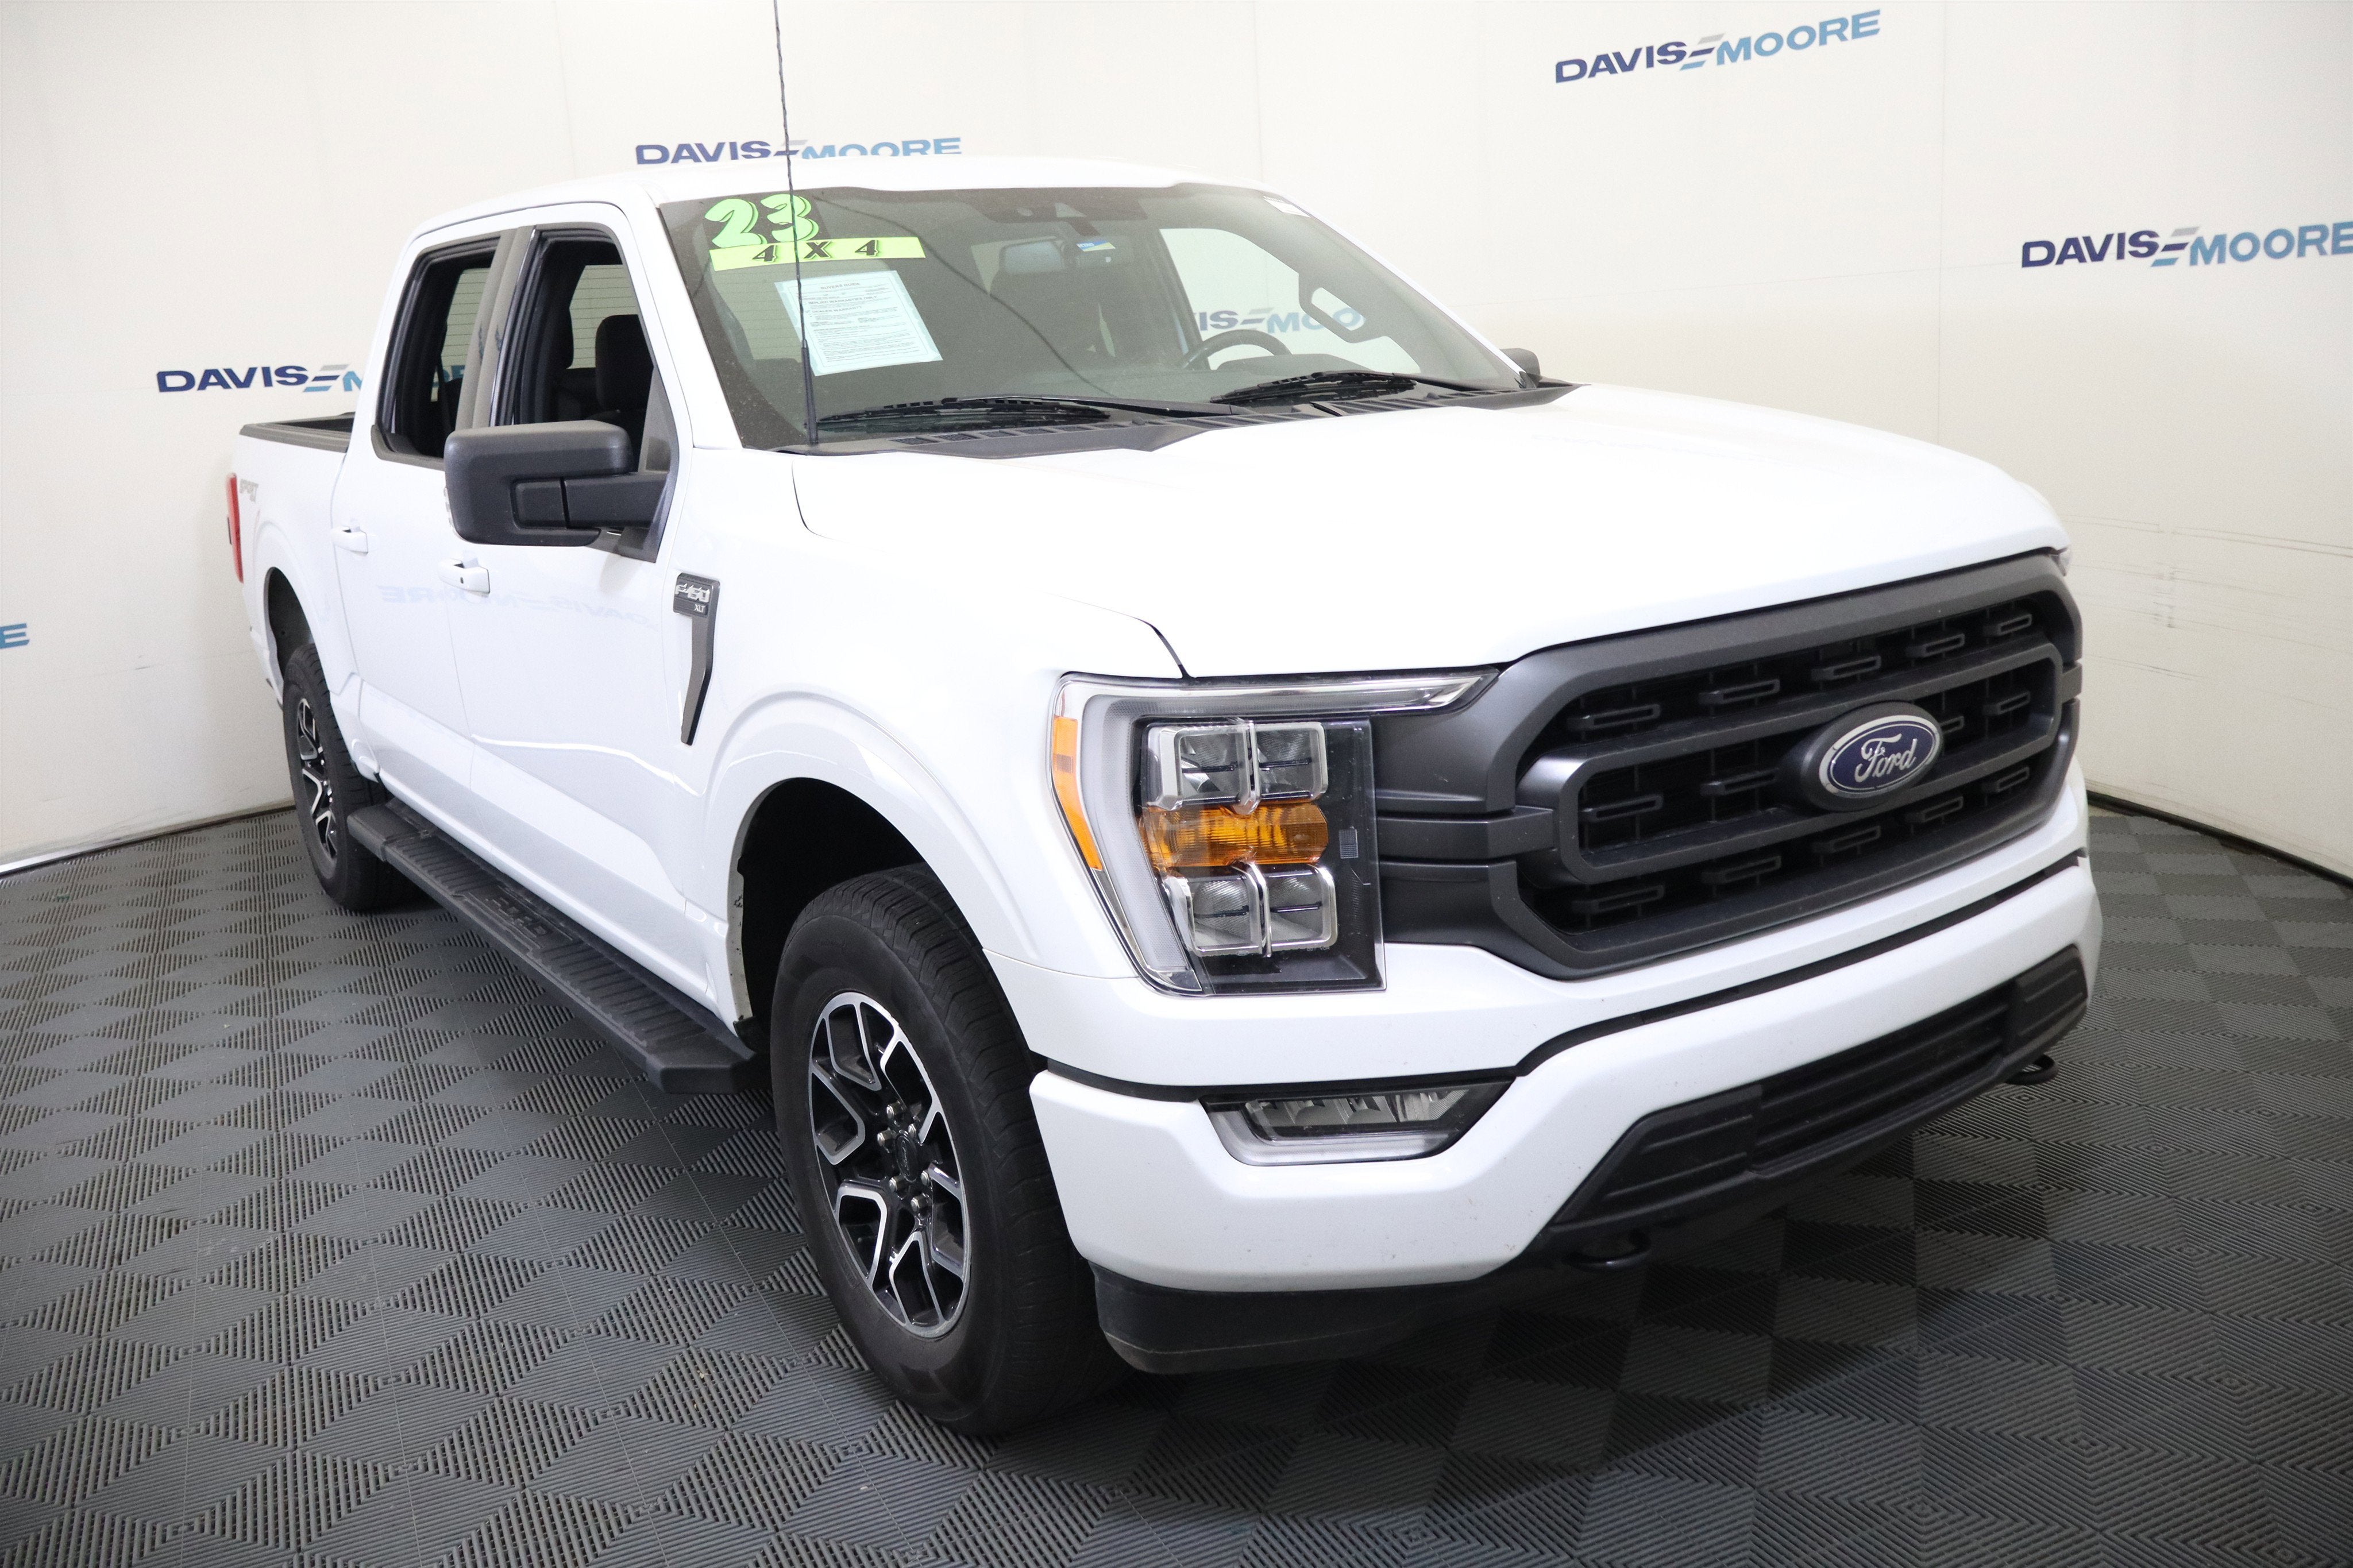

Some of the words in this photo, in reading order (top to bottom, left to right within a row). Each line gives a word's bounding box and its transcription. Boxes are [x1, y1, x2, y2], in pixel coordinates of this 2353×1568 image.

[1555, 41, 1687, 84] DAVIS
[1716, 9, 1881, 67] MOORE
[635, 141, 772, 165] DAVIS
[704, 194, 820, 248] 23
[753, 245, 778, 263] 4
[854, 240, 880, 257] 4
[2021, 230, 2160, 268] DAVIS
[2189, 221, 2353, 266] MOORE
[157, 365, 309, 392] DAVIS
[694, 604, 706, 613] XLT
[1854, 733, 1918, 783] Ford
